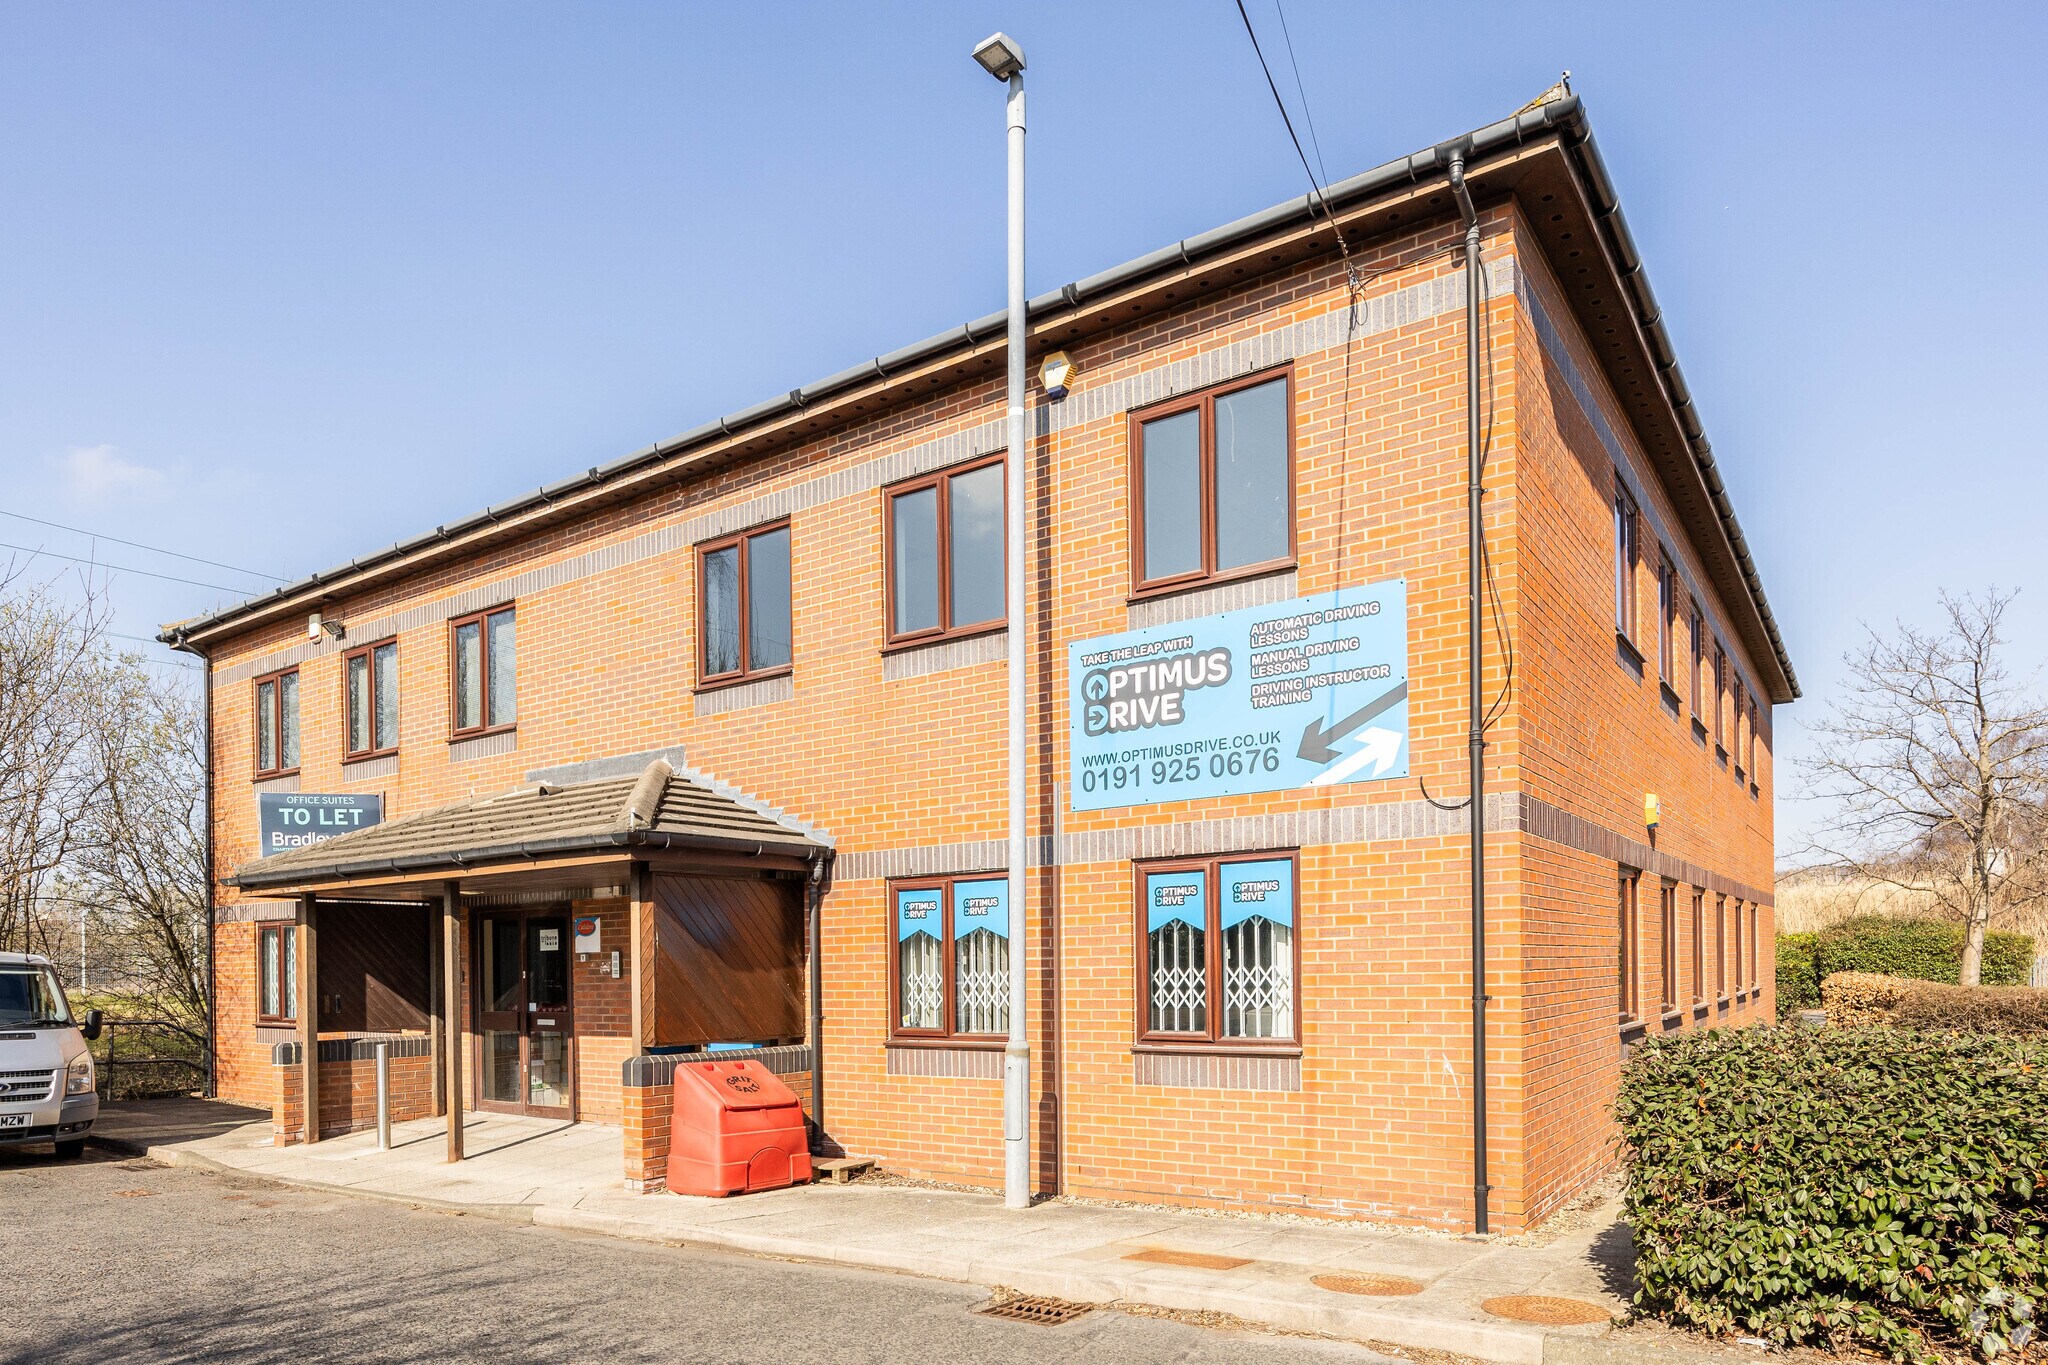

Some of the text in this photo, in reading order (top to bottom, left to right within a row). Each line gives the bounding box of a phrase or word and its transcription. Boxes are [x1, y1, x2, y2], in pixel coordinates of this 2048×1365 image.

[1250, 601, 1380, 637] AUTOMATIC DRIVING
[1250, 628, 1309, 648] LESSONS
[1081, 635, 1193, 667] TAKE THE LEAP WITH
[1250, 637, 1360, 667] MANUAL DRIVING
[1083, 650, 1230, 702] OPTIMUS
[1251, 659, 1309, 679] LESSONS
[1251, 664, 1391, 697] DRIVING INSTRUCTOR
[1251, 690, 1312, 709] TRAINING
[1086, 690, 1182, 734] DRIVE
[1082, 730, 1281, 768] WWW.OPTIMUSDRIVE.CO.UK
[1082, 746, 1280, 793] 0191 925 0676
[286, 796, 355, 805] OFFICE SUITES
[278, 807, 364, 826] TO LET
[1155, 885, 1198, 897] OPTIMUS
[1232, 880, 1279, 893] OPTIMUS
[904, 900, 937, 911] OPTIMUS
[963, 896, 999, 908] OPTIMUS
[1155, 896, 1185, 907] DRIVE
[1233, 892, 1266, 903] DRIVE
[904, 910, 928, 919] DRIVE
[963, 907, 989, 916] DRIVE
[726, 1076, 752, 1085] GRIT
[735, 1083, 760, 1093] SALT
[0, 1115, 25, 1127] MZW
